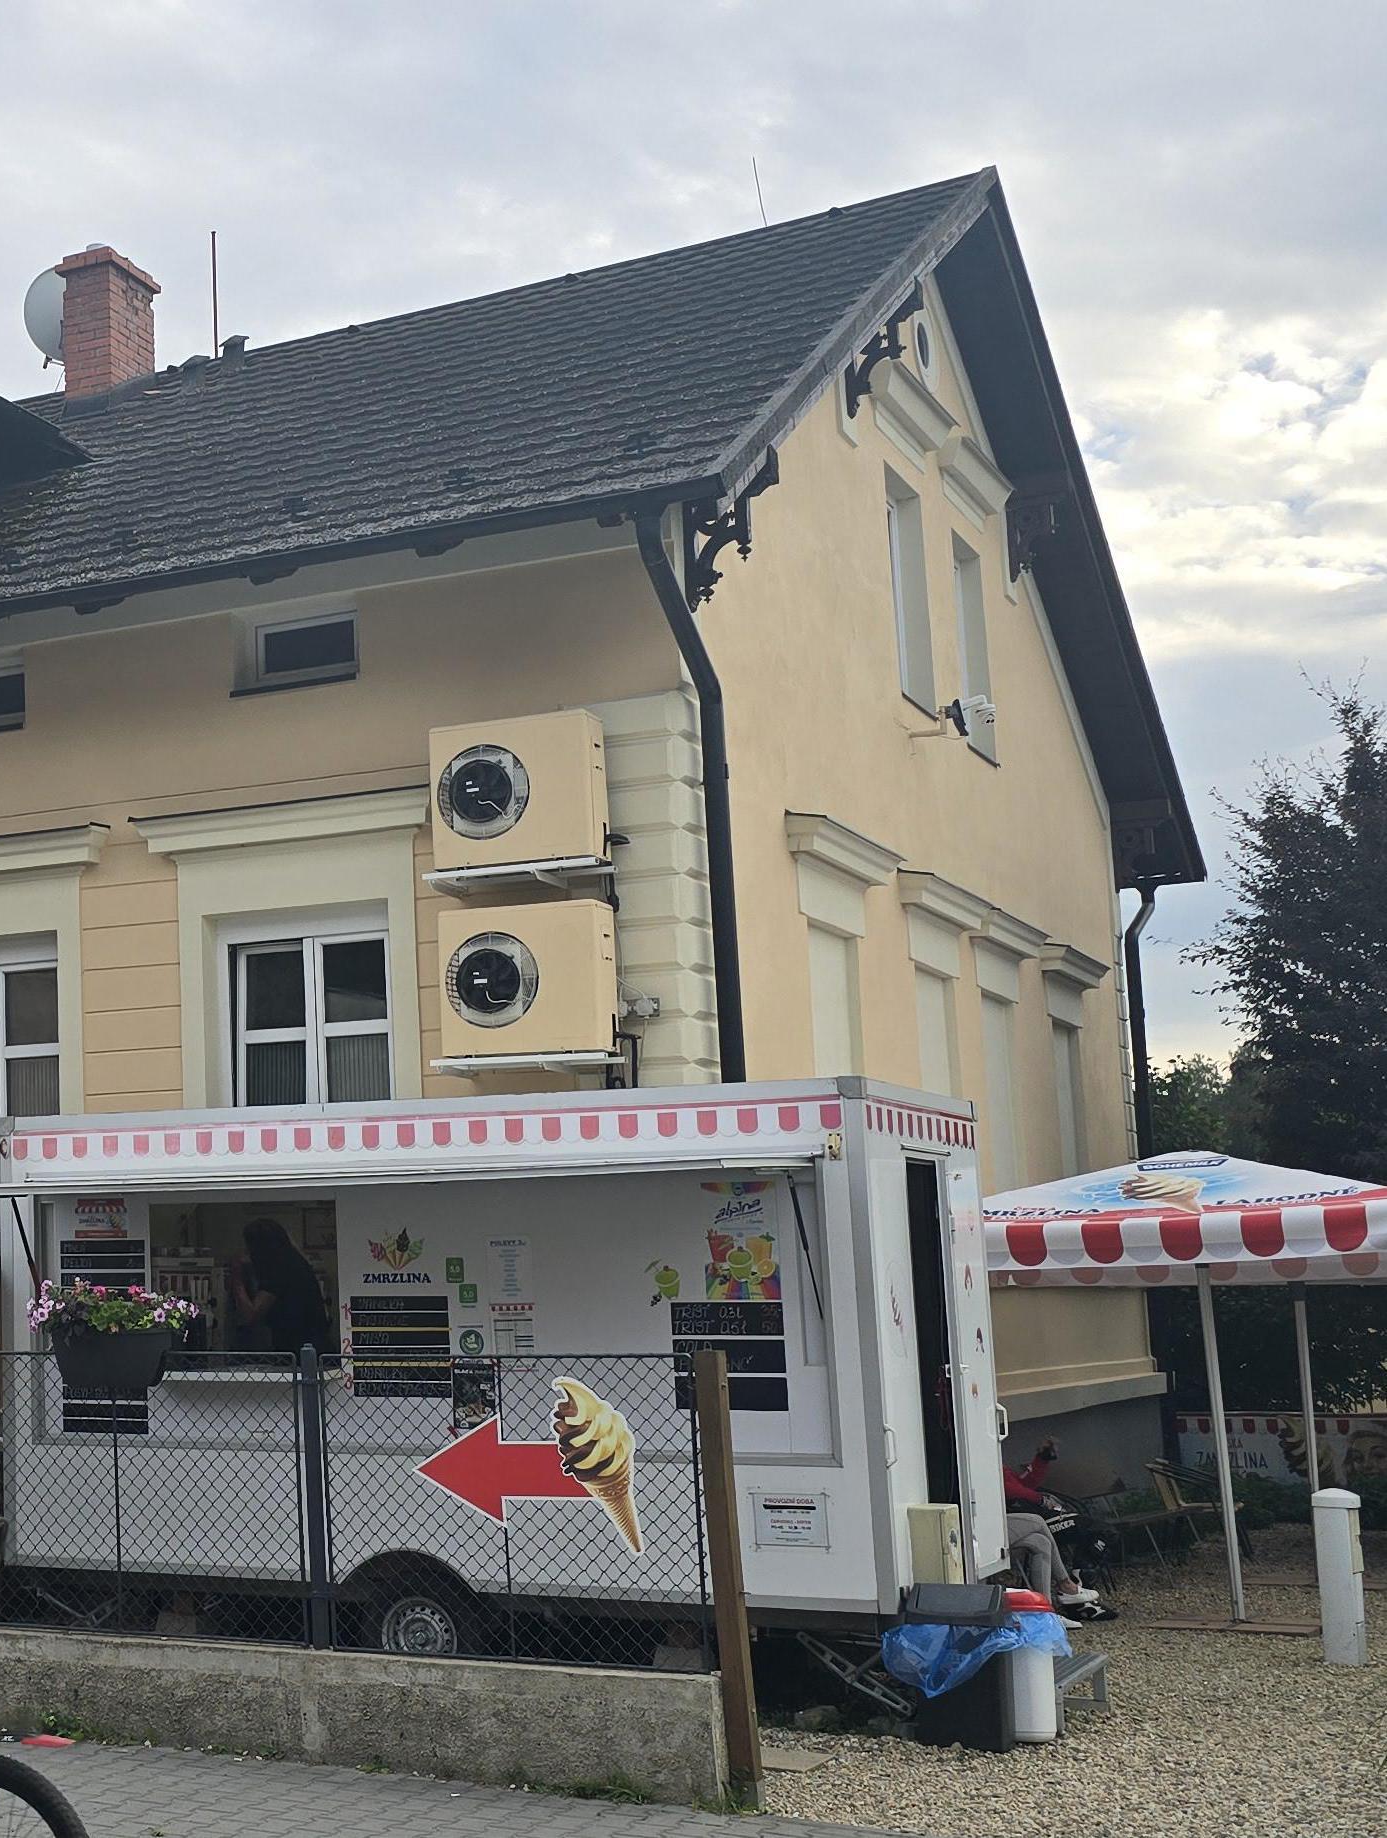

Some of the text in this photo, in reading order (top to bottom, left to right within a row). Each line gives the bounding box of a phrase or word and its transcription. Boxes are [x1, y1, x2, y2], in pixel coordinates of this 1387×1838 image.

[1142, 1159, 1222, 1170] BOHEMILK
[983, 1208, 1101, 1217] MRZLINA
[363, 1273, 432, 1284] ZMRZLINA
[1196, 1450, 1269, 1469] ZMZLINA
[1049, 1519, 1076, 1533] BIKER
